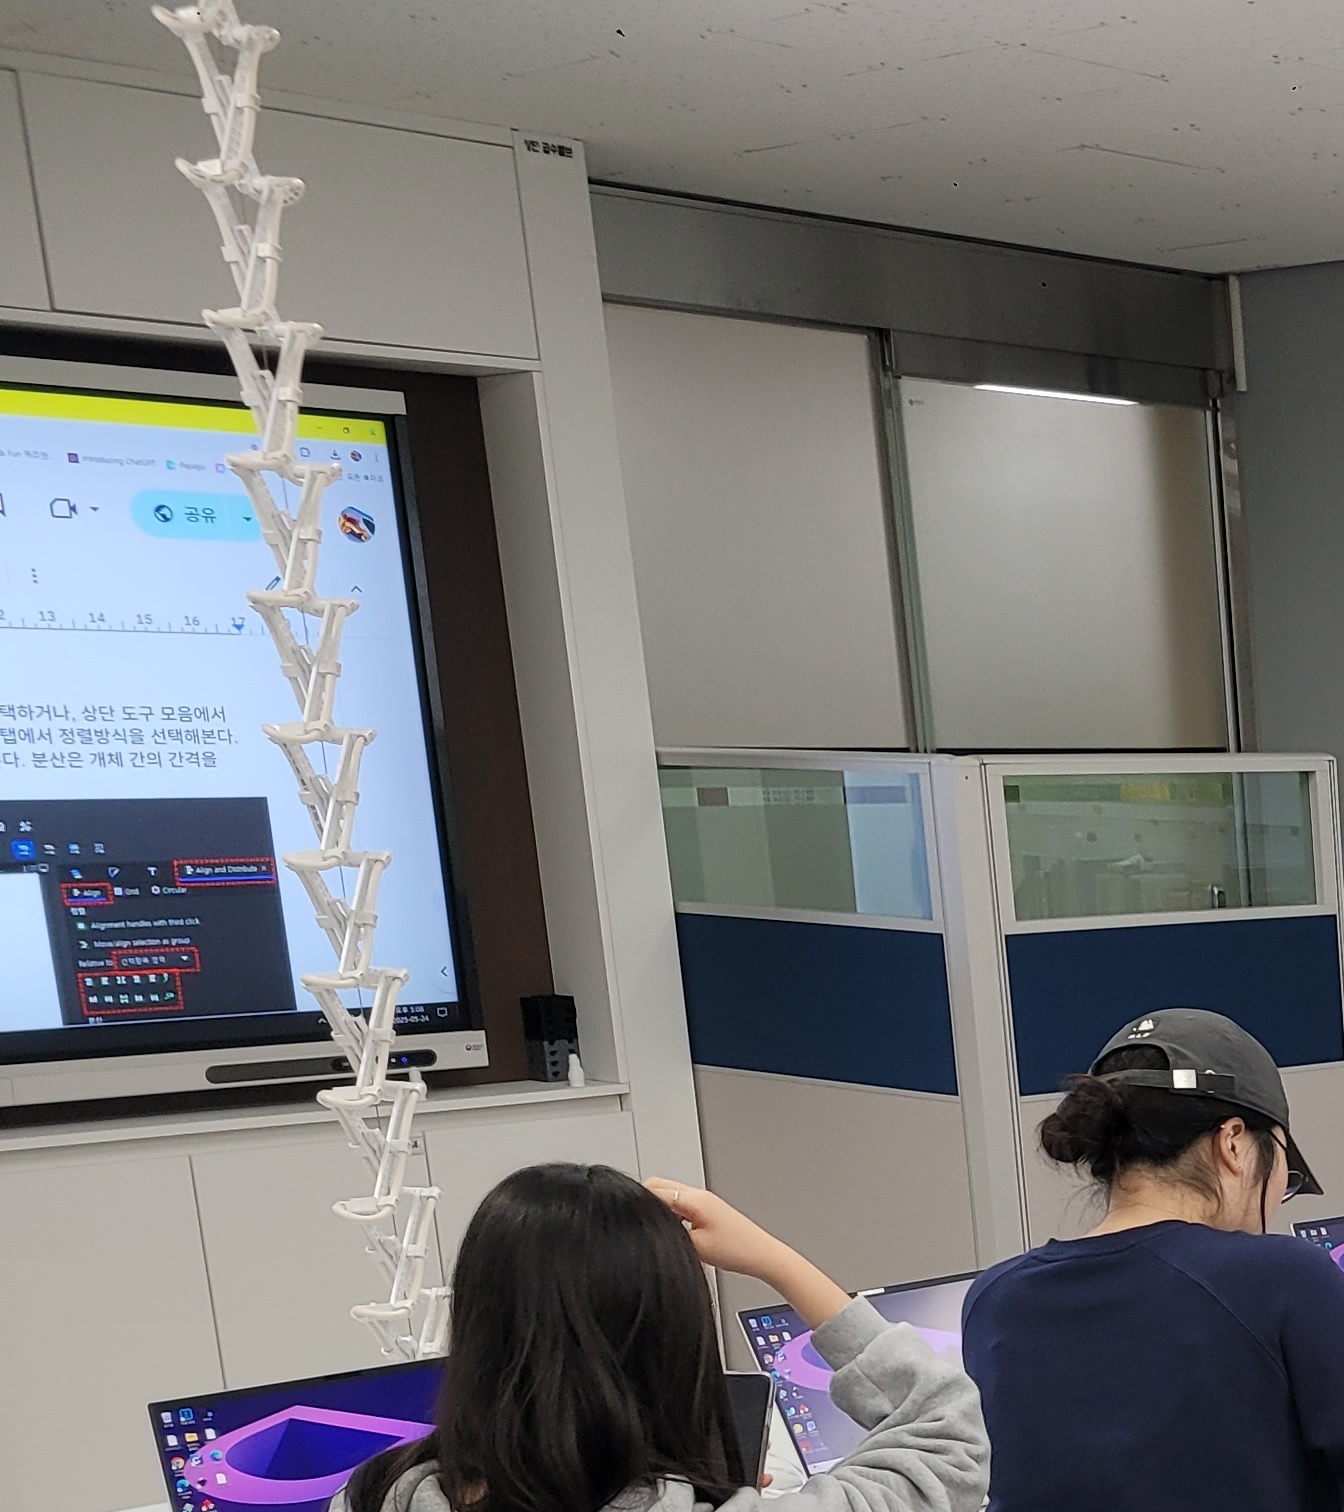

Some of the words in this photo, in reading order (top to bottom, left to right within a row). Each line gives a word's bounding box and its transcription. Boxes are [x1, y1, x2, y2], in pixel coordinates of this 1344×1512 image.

[82, 455, 122, 467] Introducing
[184, 506, 217, 524] 공유
[39, 610, 56, 622] 13
[89, 612, 105, 623] 14
[137, 614, 153, 625] 15
[184, 615, 200, 626] 16
[82, 705, 115, 722] 상단
[122, 705, 155, 722] 도구
[161, 705, 226, 723] 모음에서
[59, 728, 145, 745] 정렬방식을
[151, 728, 239, 745] 선택해본다.
[32, 751, 84, 768] 분산은
[90, 752, 124, 768] 개체
[130, 752, 163, 768] 간의
[168, 751, 217, 768] 간격을
